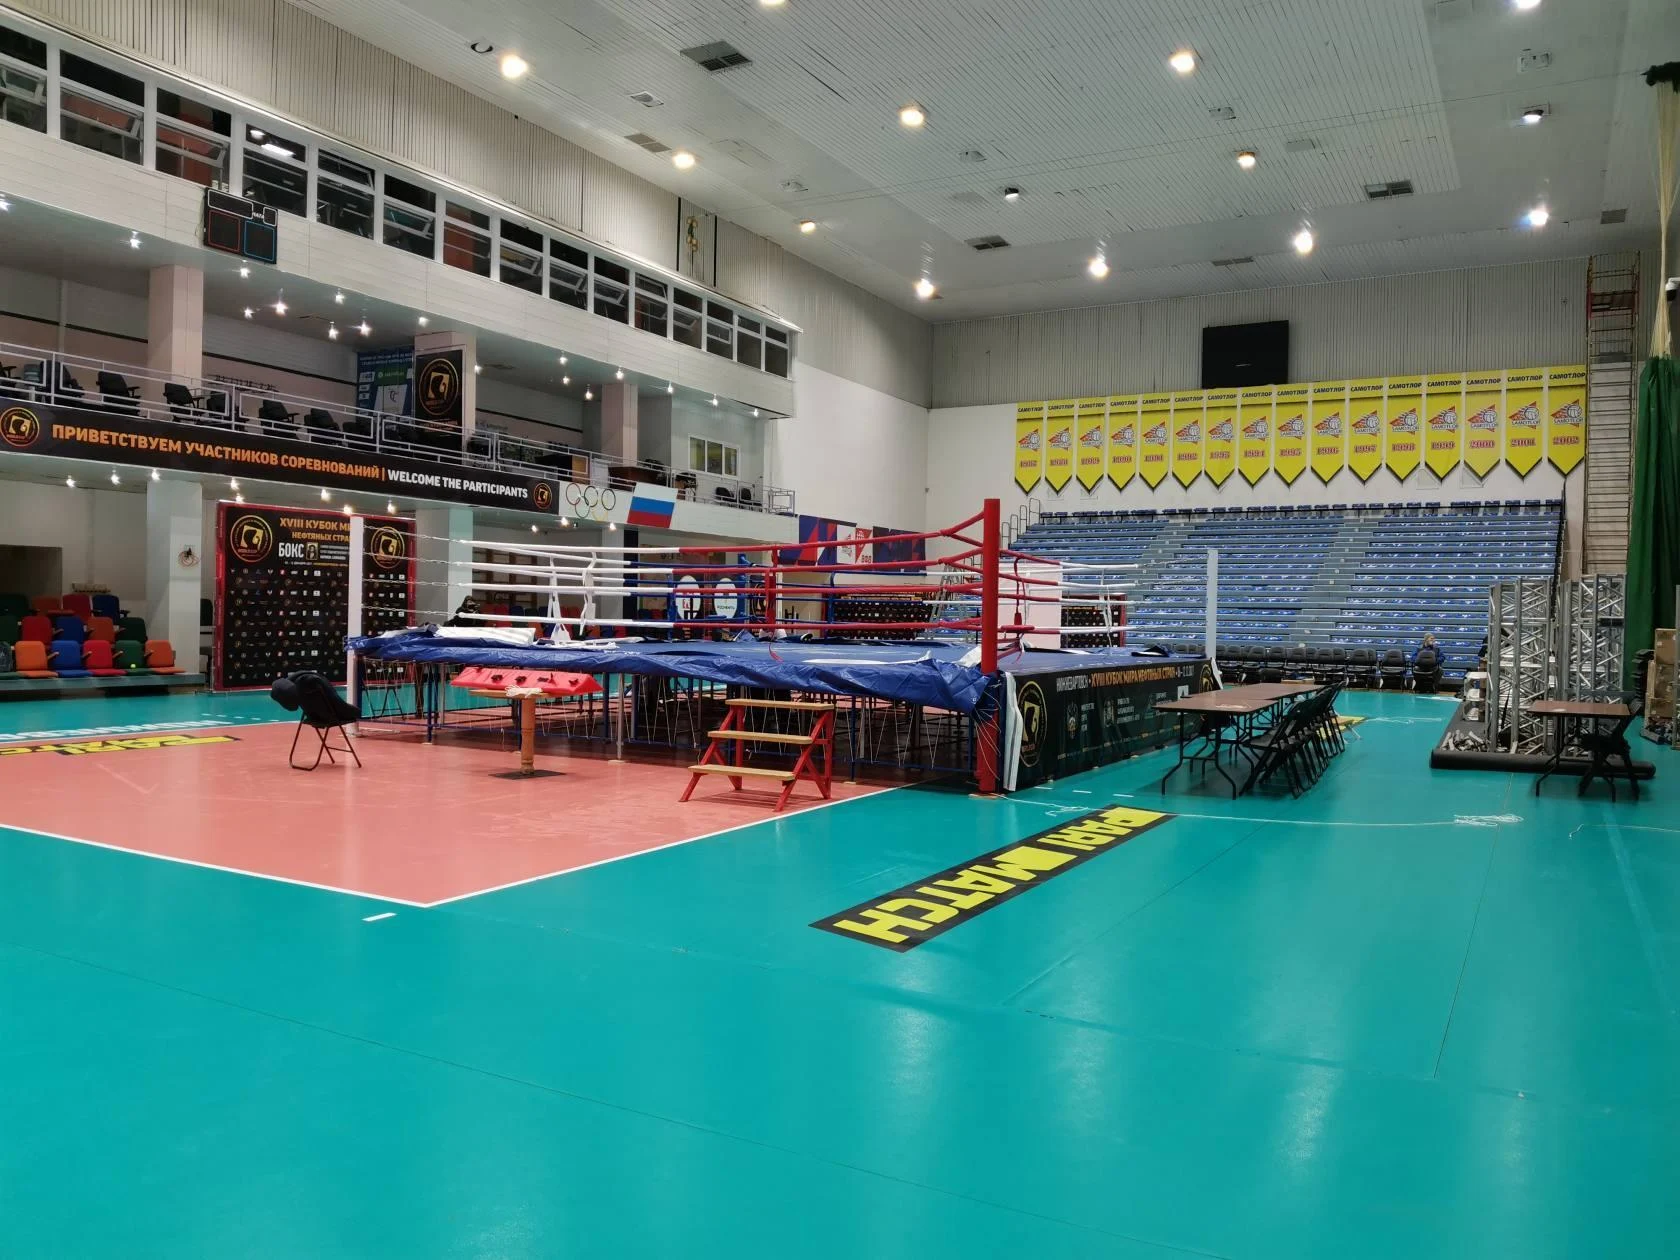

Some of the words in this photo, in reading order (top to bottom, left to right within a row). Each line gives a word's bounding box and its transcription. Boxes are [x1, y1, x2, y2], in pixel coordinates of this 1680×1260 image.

[1549, 372, 1586, 380] САМОТЛОР
[52, 424, 182, 453] ПРИВЕТСТВУЕМ
[185, 441, 278, 466] УЧАСТНИКОВ
[281, 454, 379, 478] СОРЕВНОВАНИЙ
[388, 469, 440, 486] WELCOME
[442, 477, 461, 489] THE
[463, 479, 528, 498] PARTICIPANTS
[280, 517, 304, 529] XVIII
[305, 520, 338, 531] КУБОК
[292, 531, 332, 541] НЕФТЯНЫХ
[332, 534, 352, 542] СТРА
[278, 542, 305, 558] БОКС
[1037, 807, 1168, 851] PARI
[833, 846, 1078, 943] MATCH
